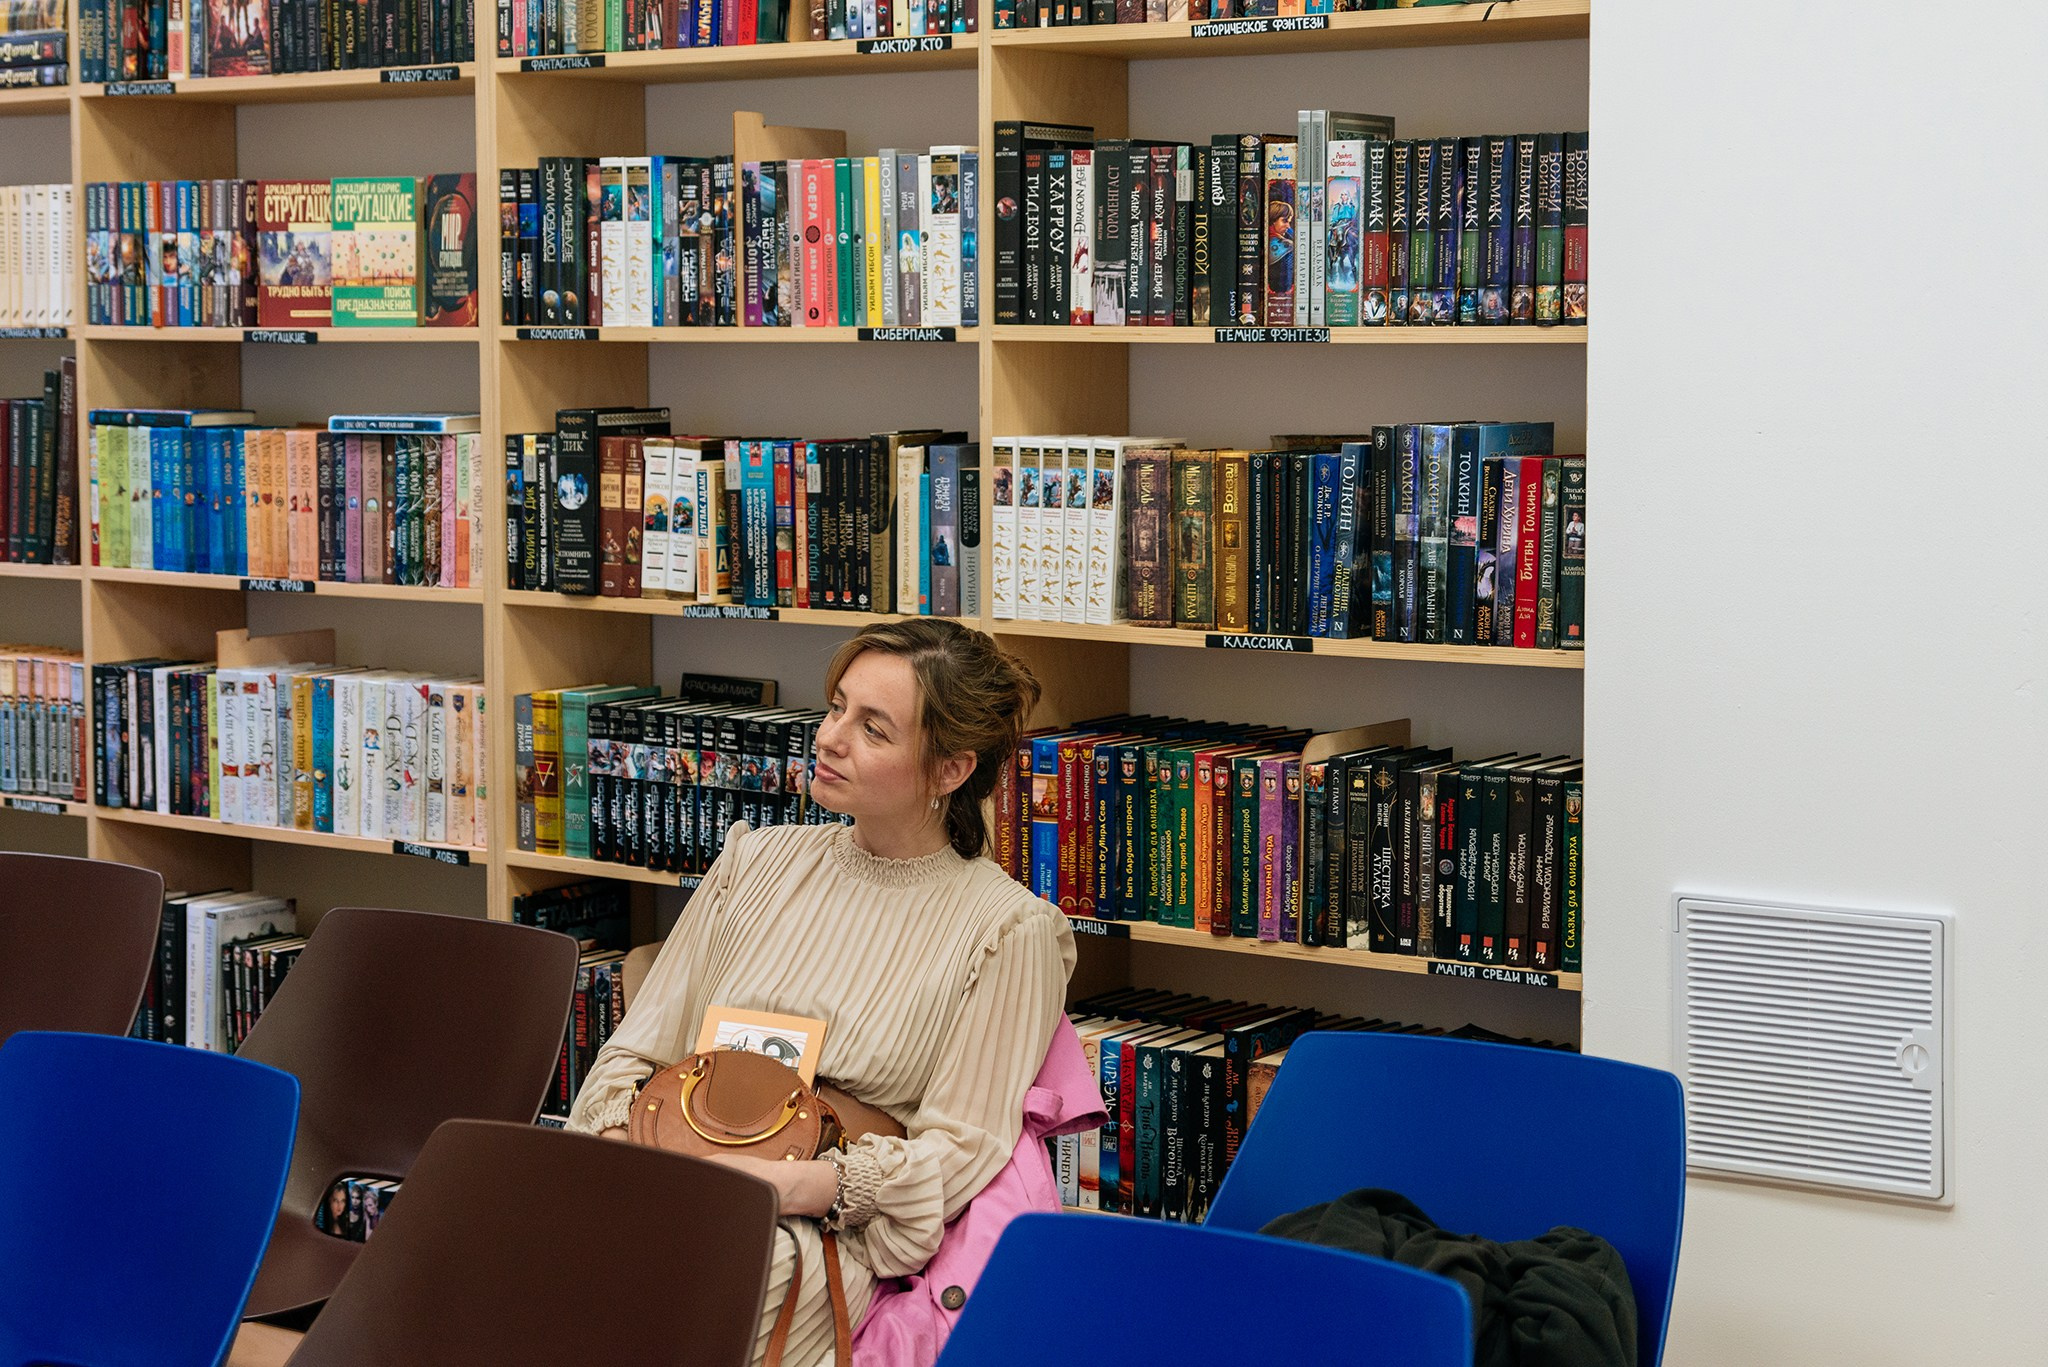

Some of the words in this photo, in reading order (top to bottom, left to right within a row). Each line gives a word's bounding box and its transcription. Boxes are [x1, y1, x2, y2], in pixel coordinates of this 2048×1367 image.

[870, 40, 917, 53] ДОКТОР
[920, 38, 943, 51] КТО
[1194, 20, 1268, 37] ИСТОРИЧЕСКОЕ
[1272, 16, 1324, 34] ФЭНТЕЗИ
[531, 57, 591, 70] ФАНТАСТИКА
[311, 184, 331, 194] БОРИ
[336, 183, 368, 193] АРКАДИЙ
[377, 183, 400, 192] БОРИС
[546, 163, 555, 201] МАРС
[564, 164, 573, 201] МАРС
[808, 175, 816, 220] СФЕРА
[882, 157, 890, 215] ГИБСОН
[1108, 166, 1119, 239] ГОРМЕНГАСТ
[1370, 148, 1384, 227] ВЕДЬМАК
[1393, 148, 1407, 226] ВЕДЬМАК
[1416, 146, 1431, 226] ВЕДЬМАК
[1439, 145, 1453, 220] ВЕДЬМАК
[1465, 146, 1480, 228] ВЕДЬМАК
[1488, 141, 1504, 222] ВЕДЬМАК
[1518, 141, 1534, 223] ВЕДЬМАК
[264, 195, 331, 223] СТРУГАЦК
[335, 194, 412, 222] СТРУГАЦКИЕ
[545, 203, 555, 263] ГОЛУБОЙ
[564, 203, 574, 263] ЗЕЛЕНЫЙ
[1195, 214, 1207, 275] ПОКОЙ
[337, 299, 412, 311] ПРЕДНАЗНАЧЕНИЯ
[384, 287, 411, 298] ПОИСК
[883, 255, 893, 315] УИЛЬЯМ
[252, 332, 306, 343] СТРУГАЦКИЕ
[530, 329, 585, 339] КОСМООПЕРА
[873, 329, 942, 340] КИБЕРПАНК
[1217, 329, 1265, 342] ТЁМНОЕ
[1271, 329, 1329, 341] ФЭНТЕЗИ
[1340, 455, 1355, 531] ТОЛКИН
[1402, 450, 1413, 513] ТОЛКИН
[1428, 453, 1440, 517] ТОЛКИН
[1458, 451, 1471, 514] ТОЛКИН
[1224, 636, 1293, 651] КЛАССИКА
[404, 845, 431, 857] РОБИН
[436, 852, 458, 864] ХОББ
[1000, 822, 1010, 874] ЕХНОКРАТ
[1373, 853, 1381, 900] АТЛАСА
[1381, 847, 1390, 908] ШЕСТЕРКА
[1436, 963, 1476, 977] МАГИЯ
[1483, 967, 1520, 982] СРЕДИ
[1527, 975, 1547, 985] НАС
[1061, 1141, 1071, 1185] НИЧЕГО
